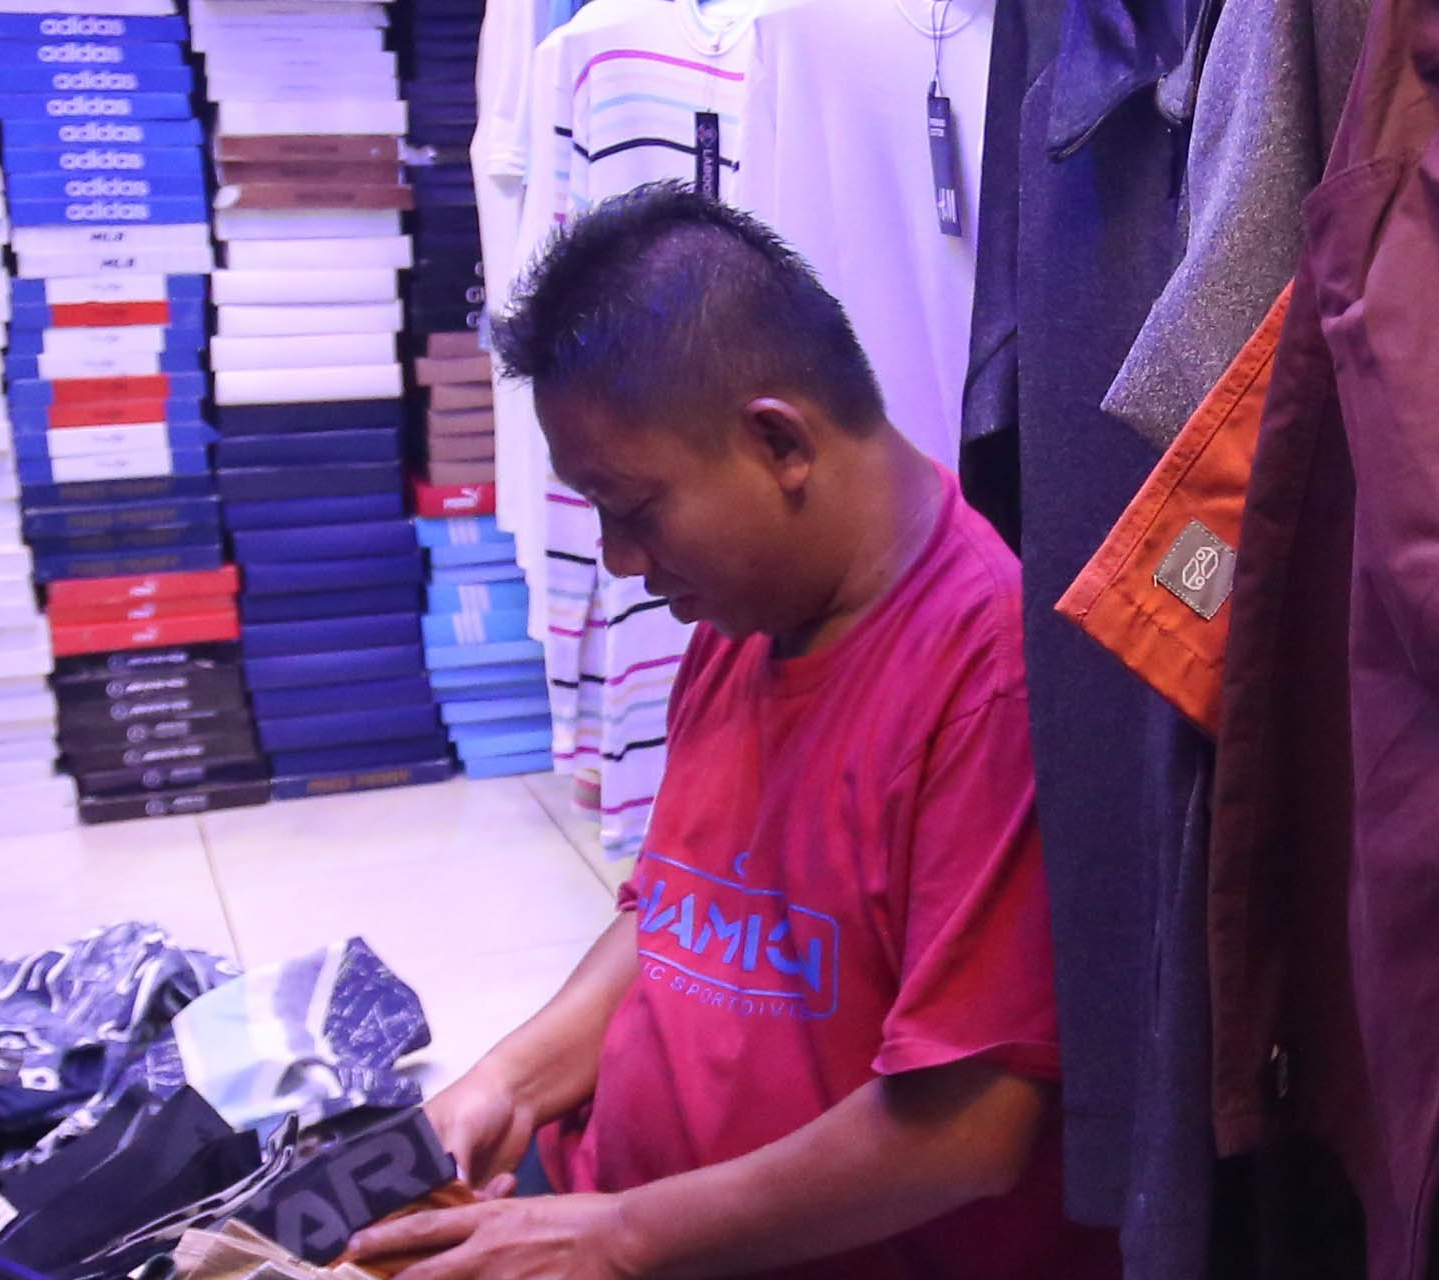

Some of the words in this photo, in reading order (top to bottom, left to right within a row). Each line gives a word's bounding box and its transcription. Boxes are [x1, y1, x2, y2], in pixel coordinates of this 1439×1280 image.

[38, 16, 127, 37] adidas
[36, 42, 124, 63] adidas
[52, 70, 138, 91] adidas
[46, 96, 131, 118] adidas
[57, 122, 144, 144] adidas
[59, 149, 145, 171] adidas
[64, 177, 151, 197] adidas
[64, 201, 151, 221] adidas
